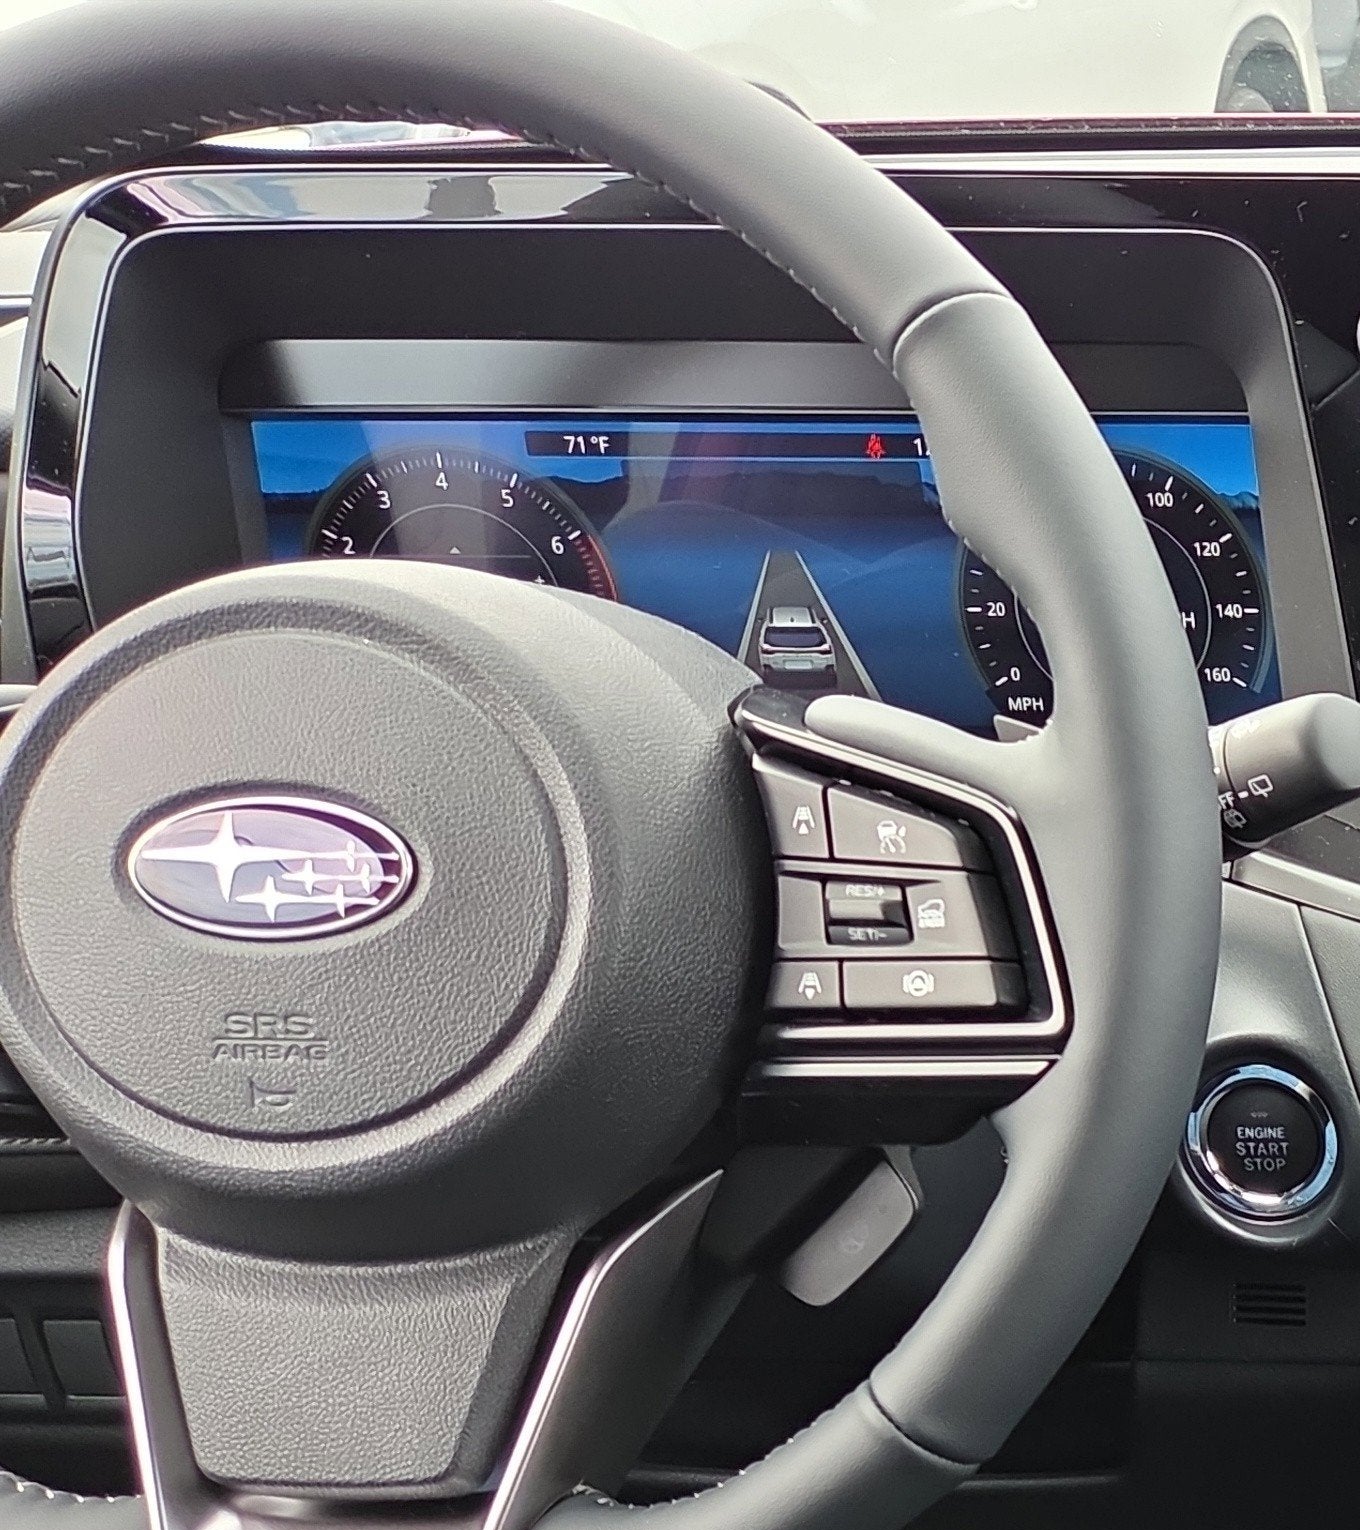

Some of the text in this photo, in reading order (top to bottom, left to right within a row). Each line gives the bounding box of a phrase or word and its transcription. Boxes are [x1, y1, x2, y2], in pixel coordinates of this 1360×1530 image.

[563, 436, 610, 454] 71°F
[436, 473, 449, 490] 4
[379, 490, 391, 509] 3
[501, 489, 514, 507] 5
[1147, 492, 1174, 508] 100
[342, 537, 355, 555] 2
[551, 537, 565, 555] 6
[1193, 542, 1221, 558] 120
[987, 601, 1006, 618] 20
[1215, 604, 1243, 619] 140
[1010, 668, 1020, 683] 0
[1204, 667, 1231, 682] 160
[1008, 696, 1044, 713] MPH
[1218, 791, 1235, 810] FF
[224, 1012, 315, 1039] SRS
[213, 1042, 329, 1061] AIRBAG
[1237, 1126, 1286, 1139] ENGINE
[1235, 1142, 1289, 1157] START
[1243, 1158, 1287, 1171] STOP
